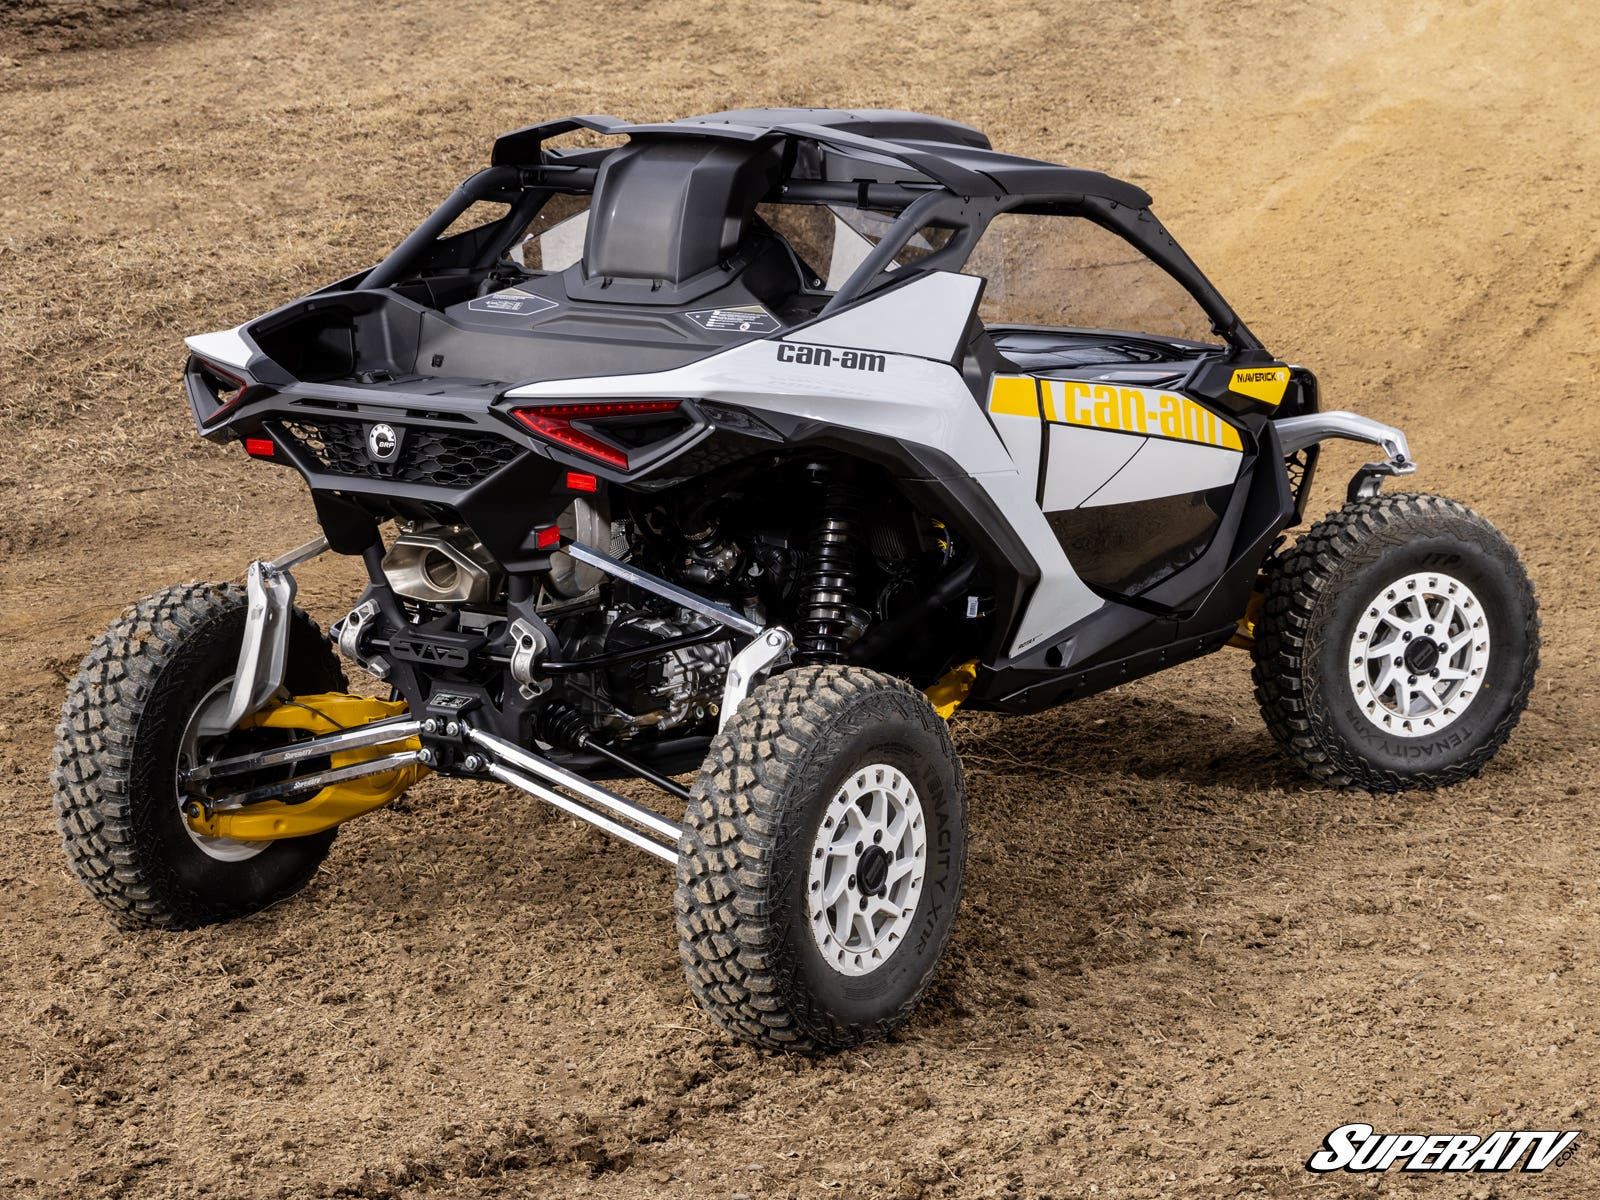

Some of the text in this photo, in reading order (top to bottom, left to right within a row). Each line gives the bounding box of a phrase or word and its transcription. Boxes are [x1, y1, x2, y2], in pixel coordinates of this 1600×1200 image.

[777, 344, 886, 373] can-am
[1236, 371, 1277, 383] MAVERICK
[378, 441, 395, 449] BRP
[1421, 552, 1461, 567] ITP
[1378, 726, 1474, 759] TENACITY
[923, 763, 951, 893] TENACITY
